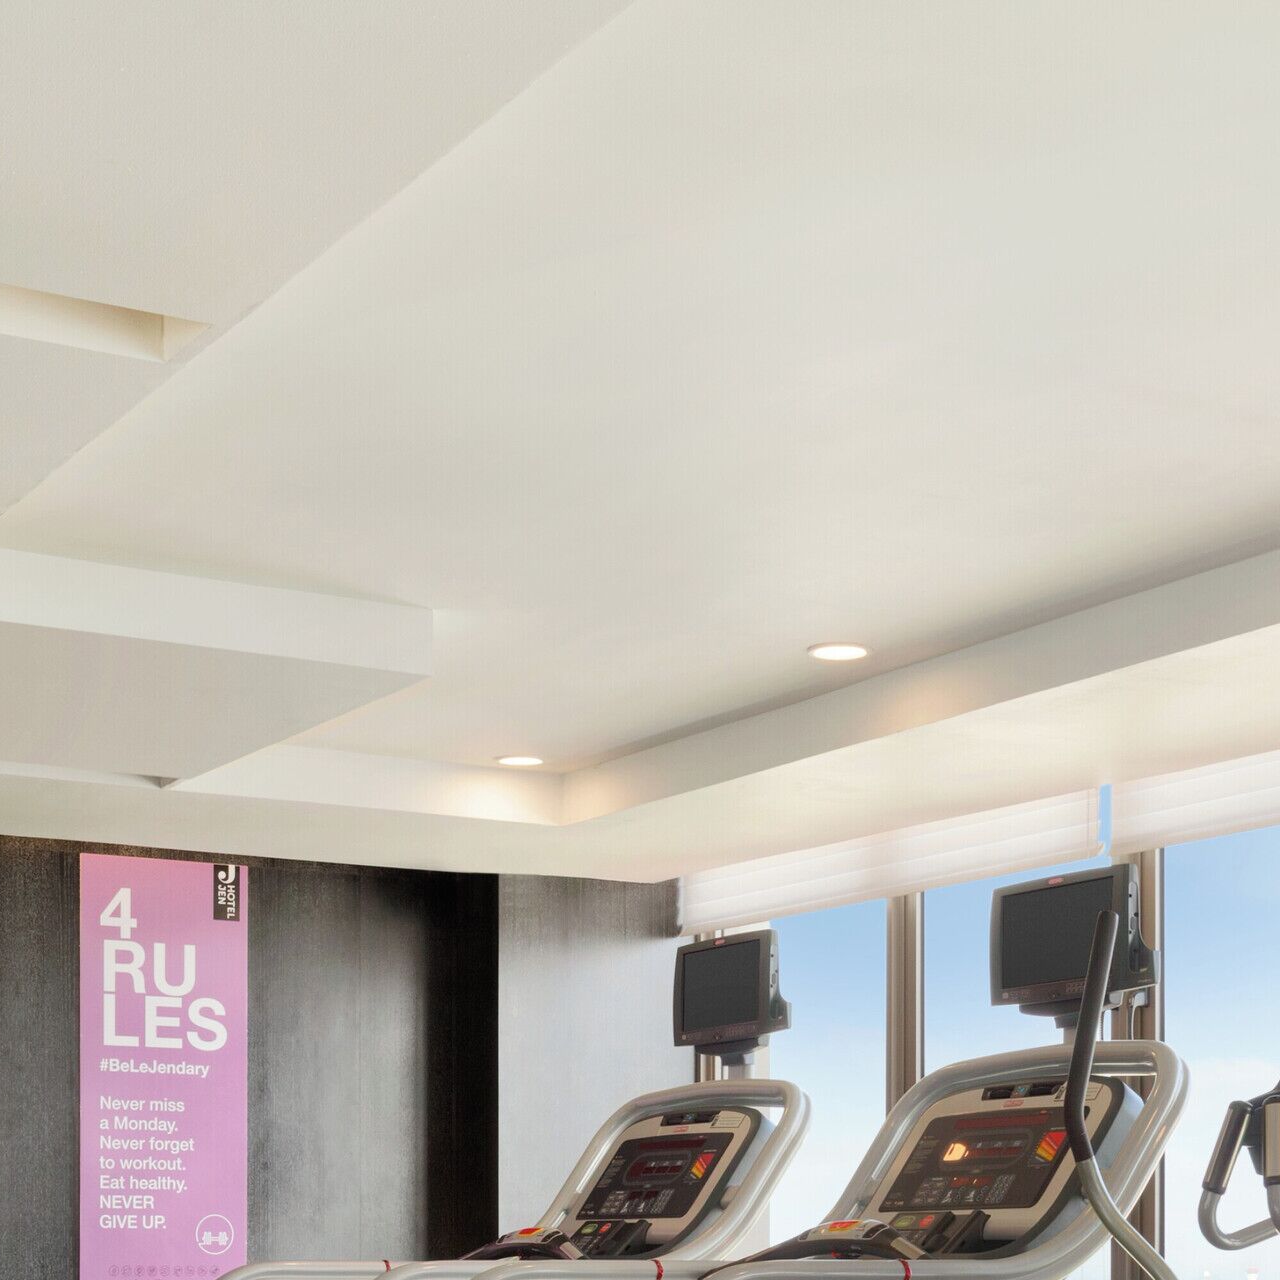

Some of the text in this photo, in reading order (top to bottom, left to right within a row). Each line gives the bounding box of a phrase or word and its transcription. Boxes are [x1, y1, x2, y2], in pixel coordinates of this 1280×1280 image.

[218, 884, 227, 905] JEN
[227, 885, 236, 919] HOTEL
[100, 887, 137, 939] 4
[103, 939, 196, 997] RU
[103, 993, 228, 1052] LES
[99, 1058, 210, 1079] #BeLeJendary
[100, 1095, 185, 1112] Never miss
[99, 1116, 178, 1135] a Monday.
[100, 1135, 195, 1154] Never forget
[99, 1156, 187, 1171] to workout.
[100, 1175, 188, 1194] Eat healthy.
[100, 1195, 155, 1210] NEVER
[99, 1215, 167, 1230] GIVE UP.
